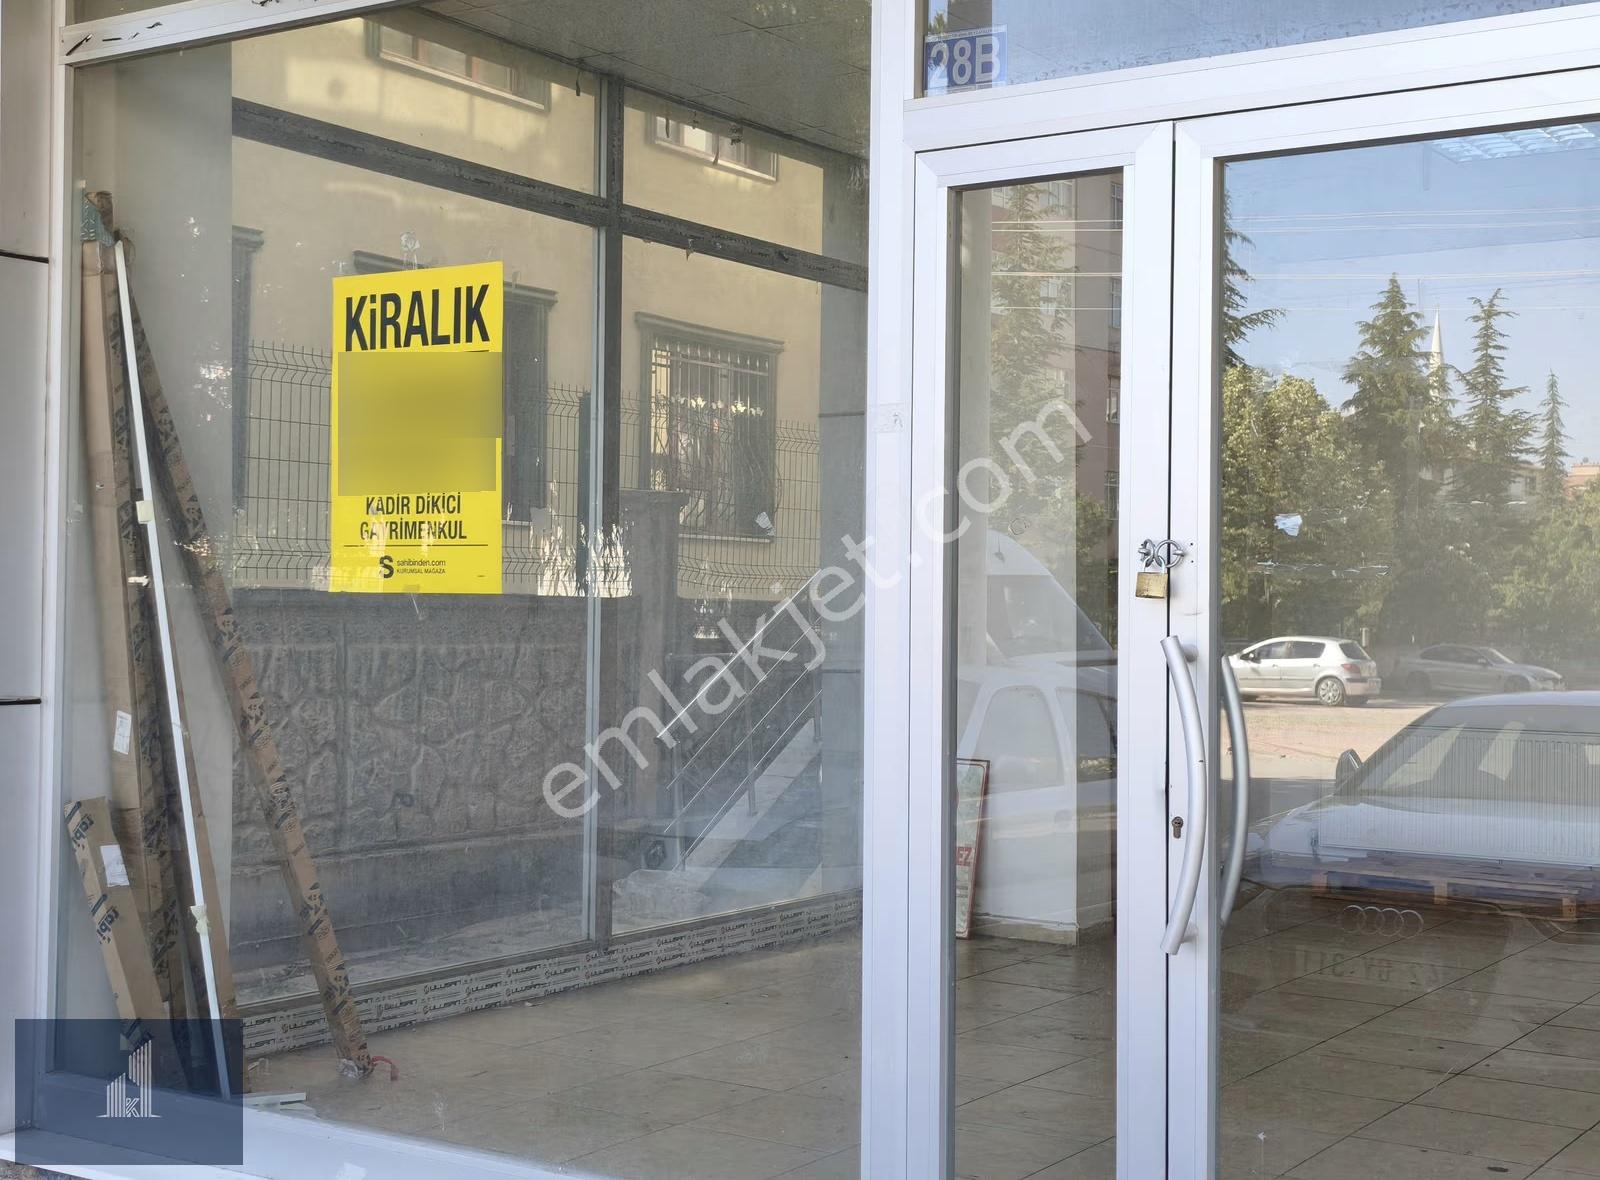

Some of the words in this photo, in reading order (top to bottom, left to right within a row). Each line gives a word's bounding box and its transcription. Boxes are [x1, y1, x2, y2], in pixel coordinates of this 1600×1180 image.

[930, 36, 1000, 87] 28B
[366, 493, 410, 515] KADİR
[416, 491, 461, 514] DİKİCİ
[397, 558, 446, 567] sahibinden.com
